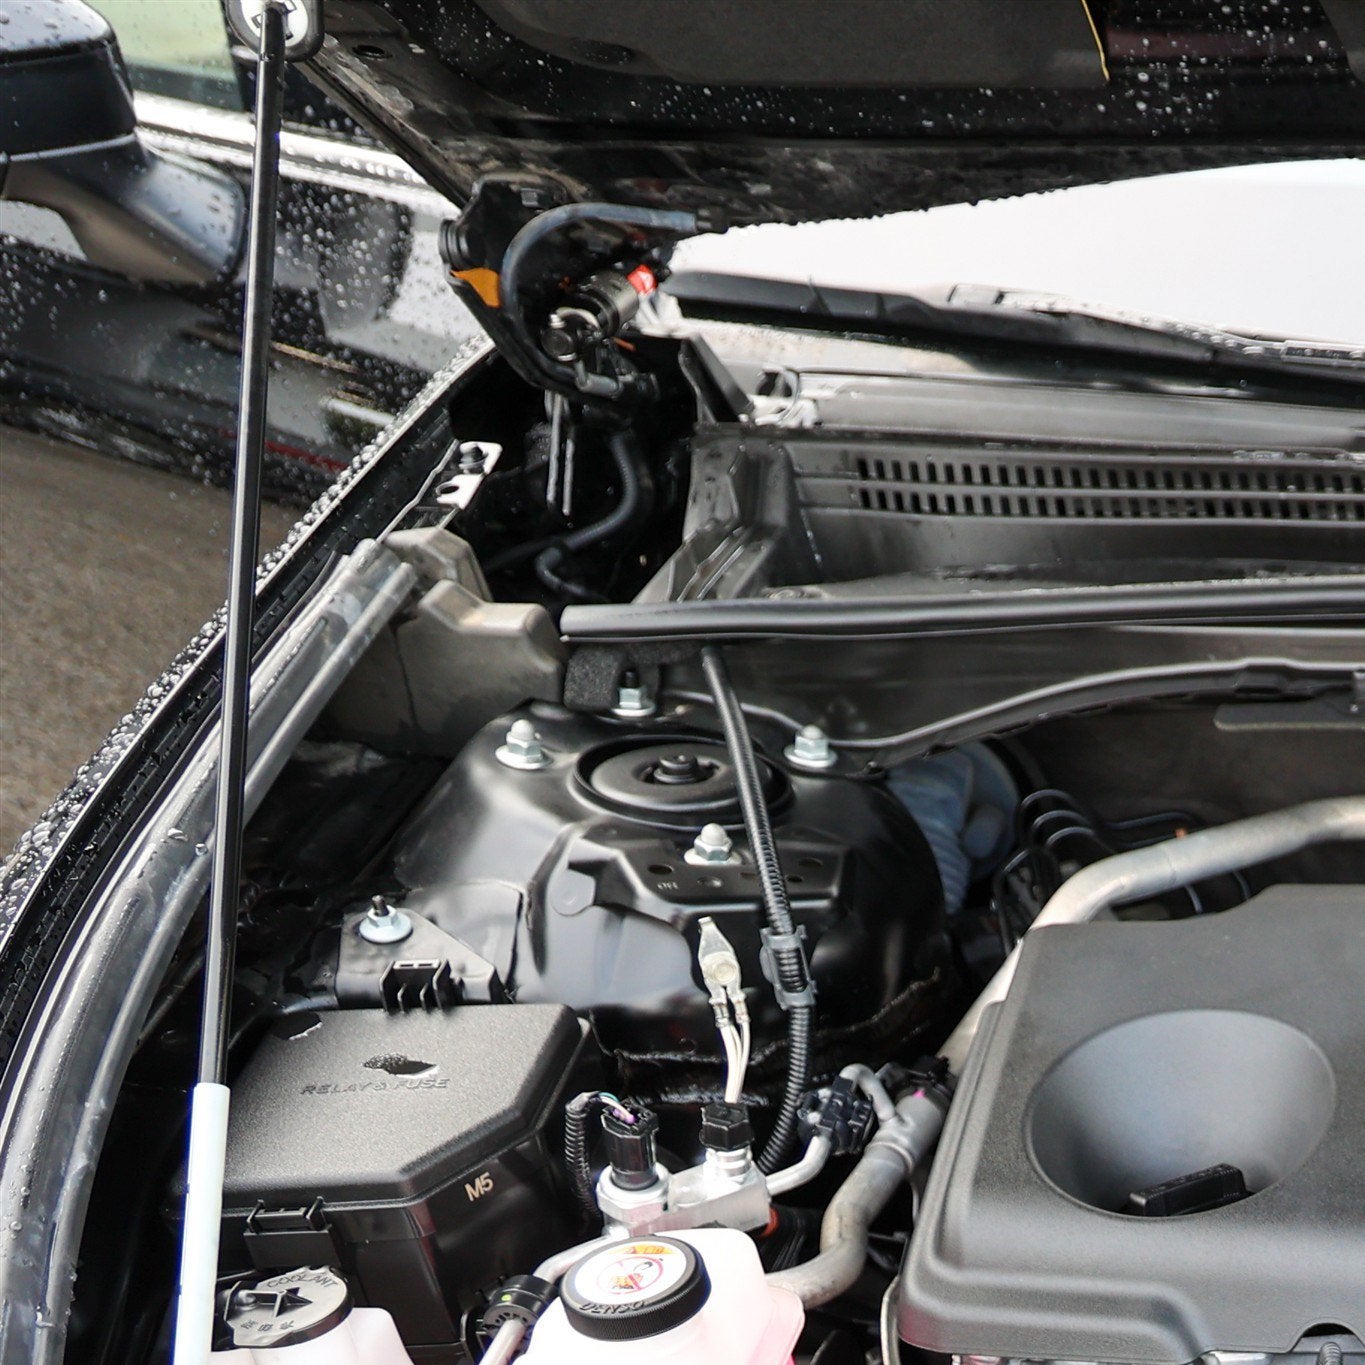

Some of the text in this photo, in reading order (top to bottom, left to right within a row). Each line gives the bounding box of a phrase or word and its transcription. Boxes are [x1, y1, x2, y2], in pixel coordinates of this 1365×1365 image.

[300, 1081, 372, 1096] RELAY
[391, 1077, 451, 1091] FUSE
[464, 1171, 495, 1202] M5
[579, 1300, 647, 1315] DENSO
